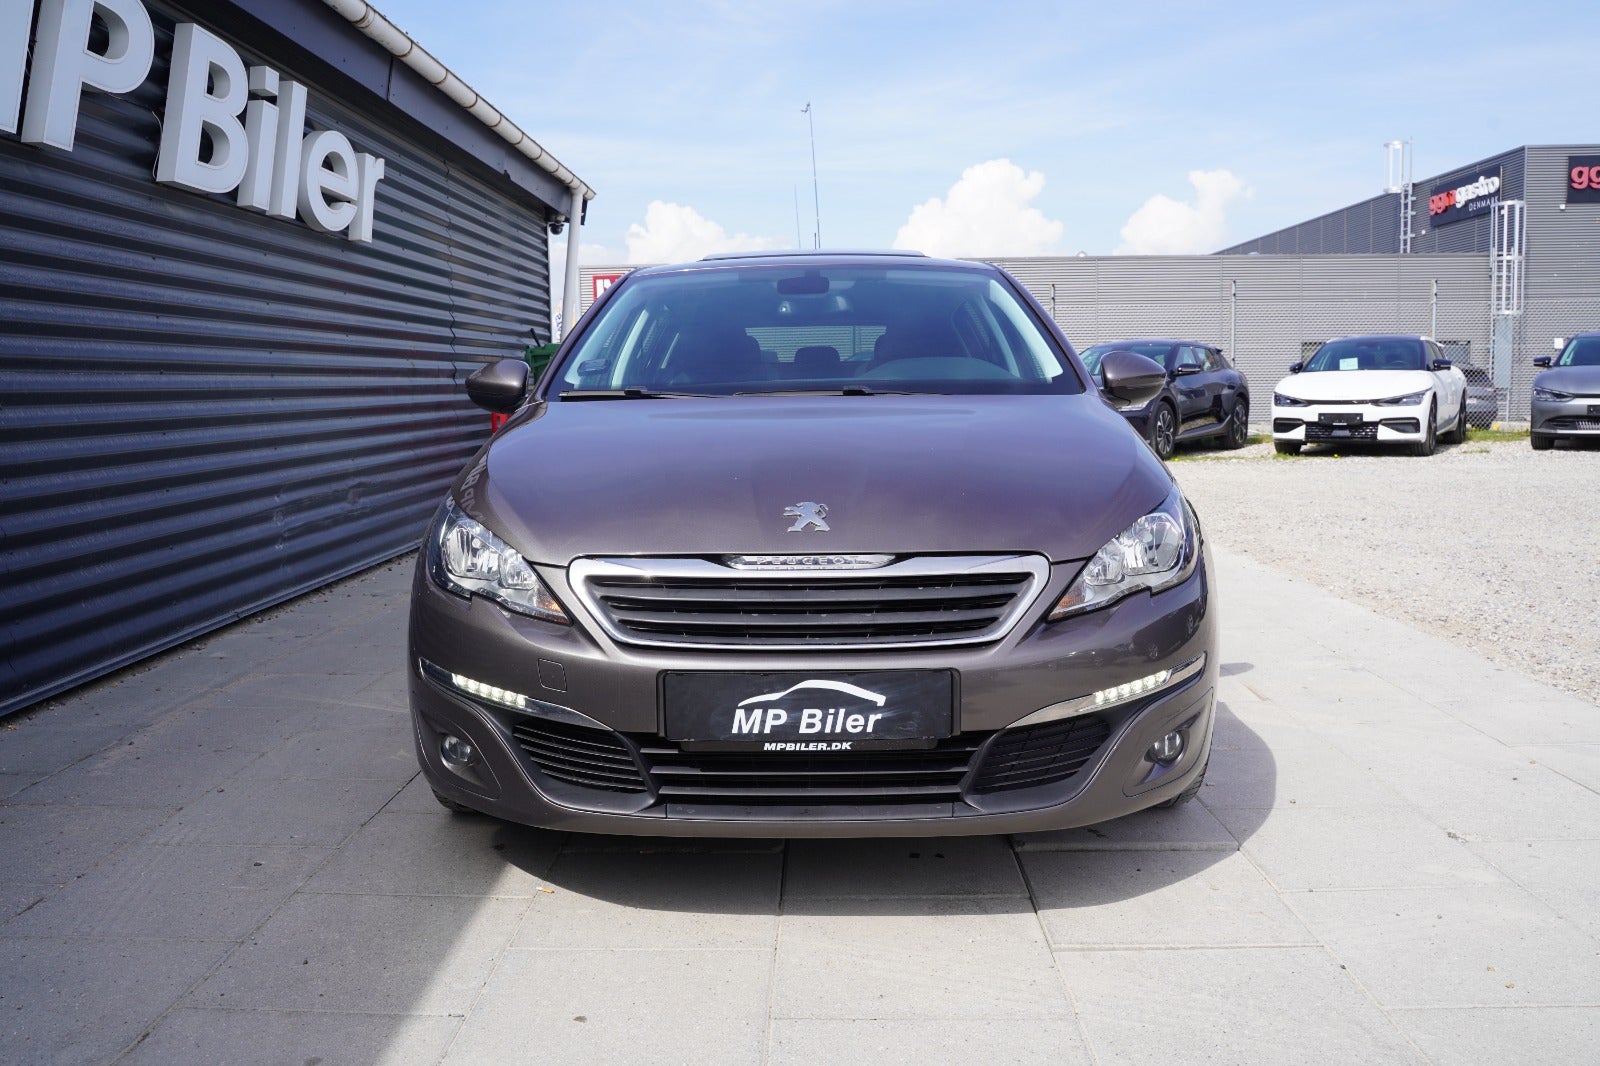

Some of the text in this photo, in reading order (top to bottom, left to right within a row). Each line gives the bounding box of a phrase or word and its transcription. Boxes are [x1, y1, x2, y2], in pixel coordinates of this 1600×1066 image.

[156, 22, 385, 243] Biler
[732, 708, 882, 734] MP Biler
[763, 742, 853, 751] MPBILER.DK
